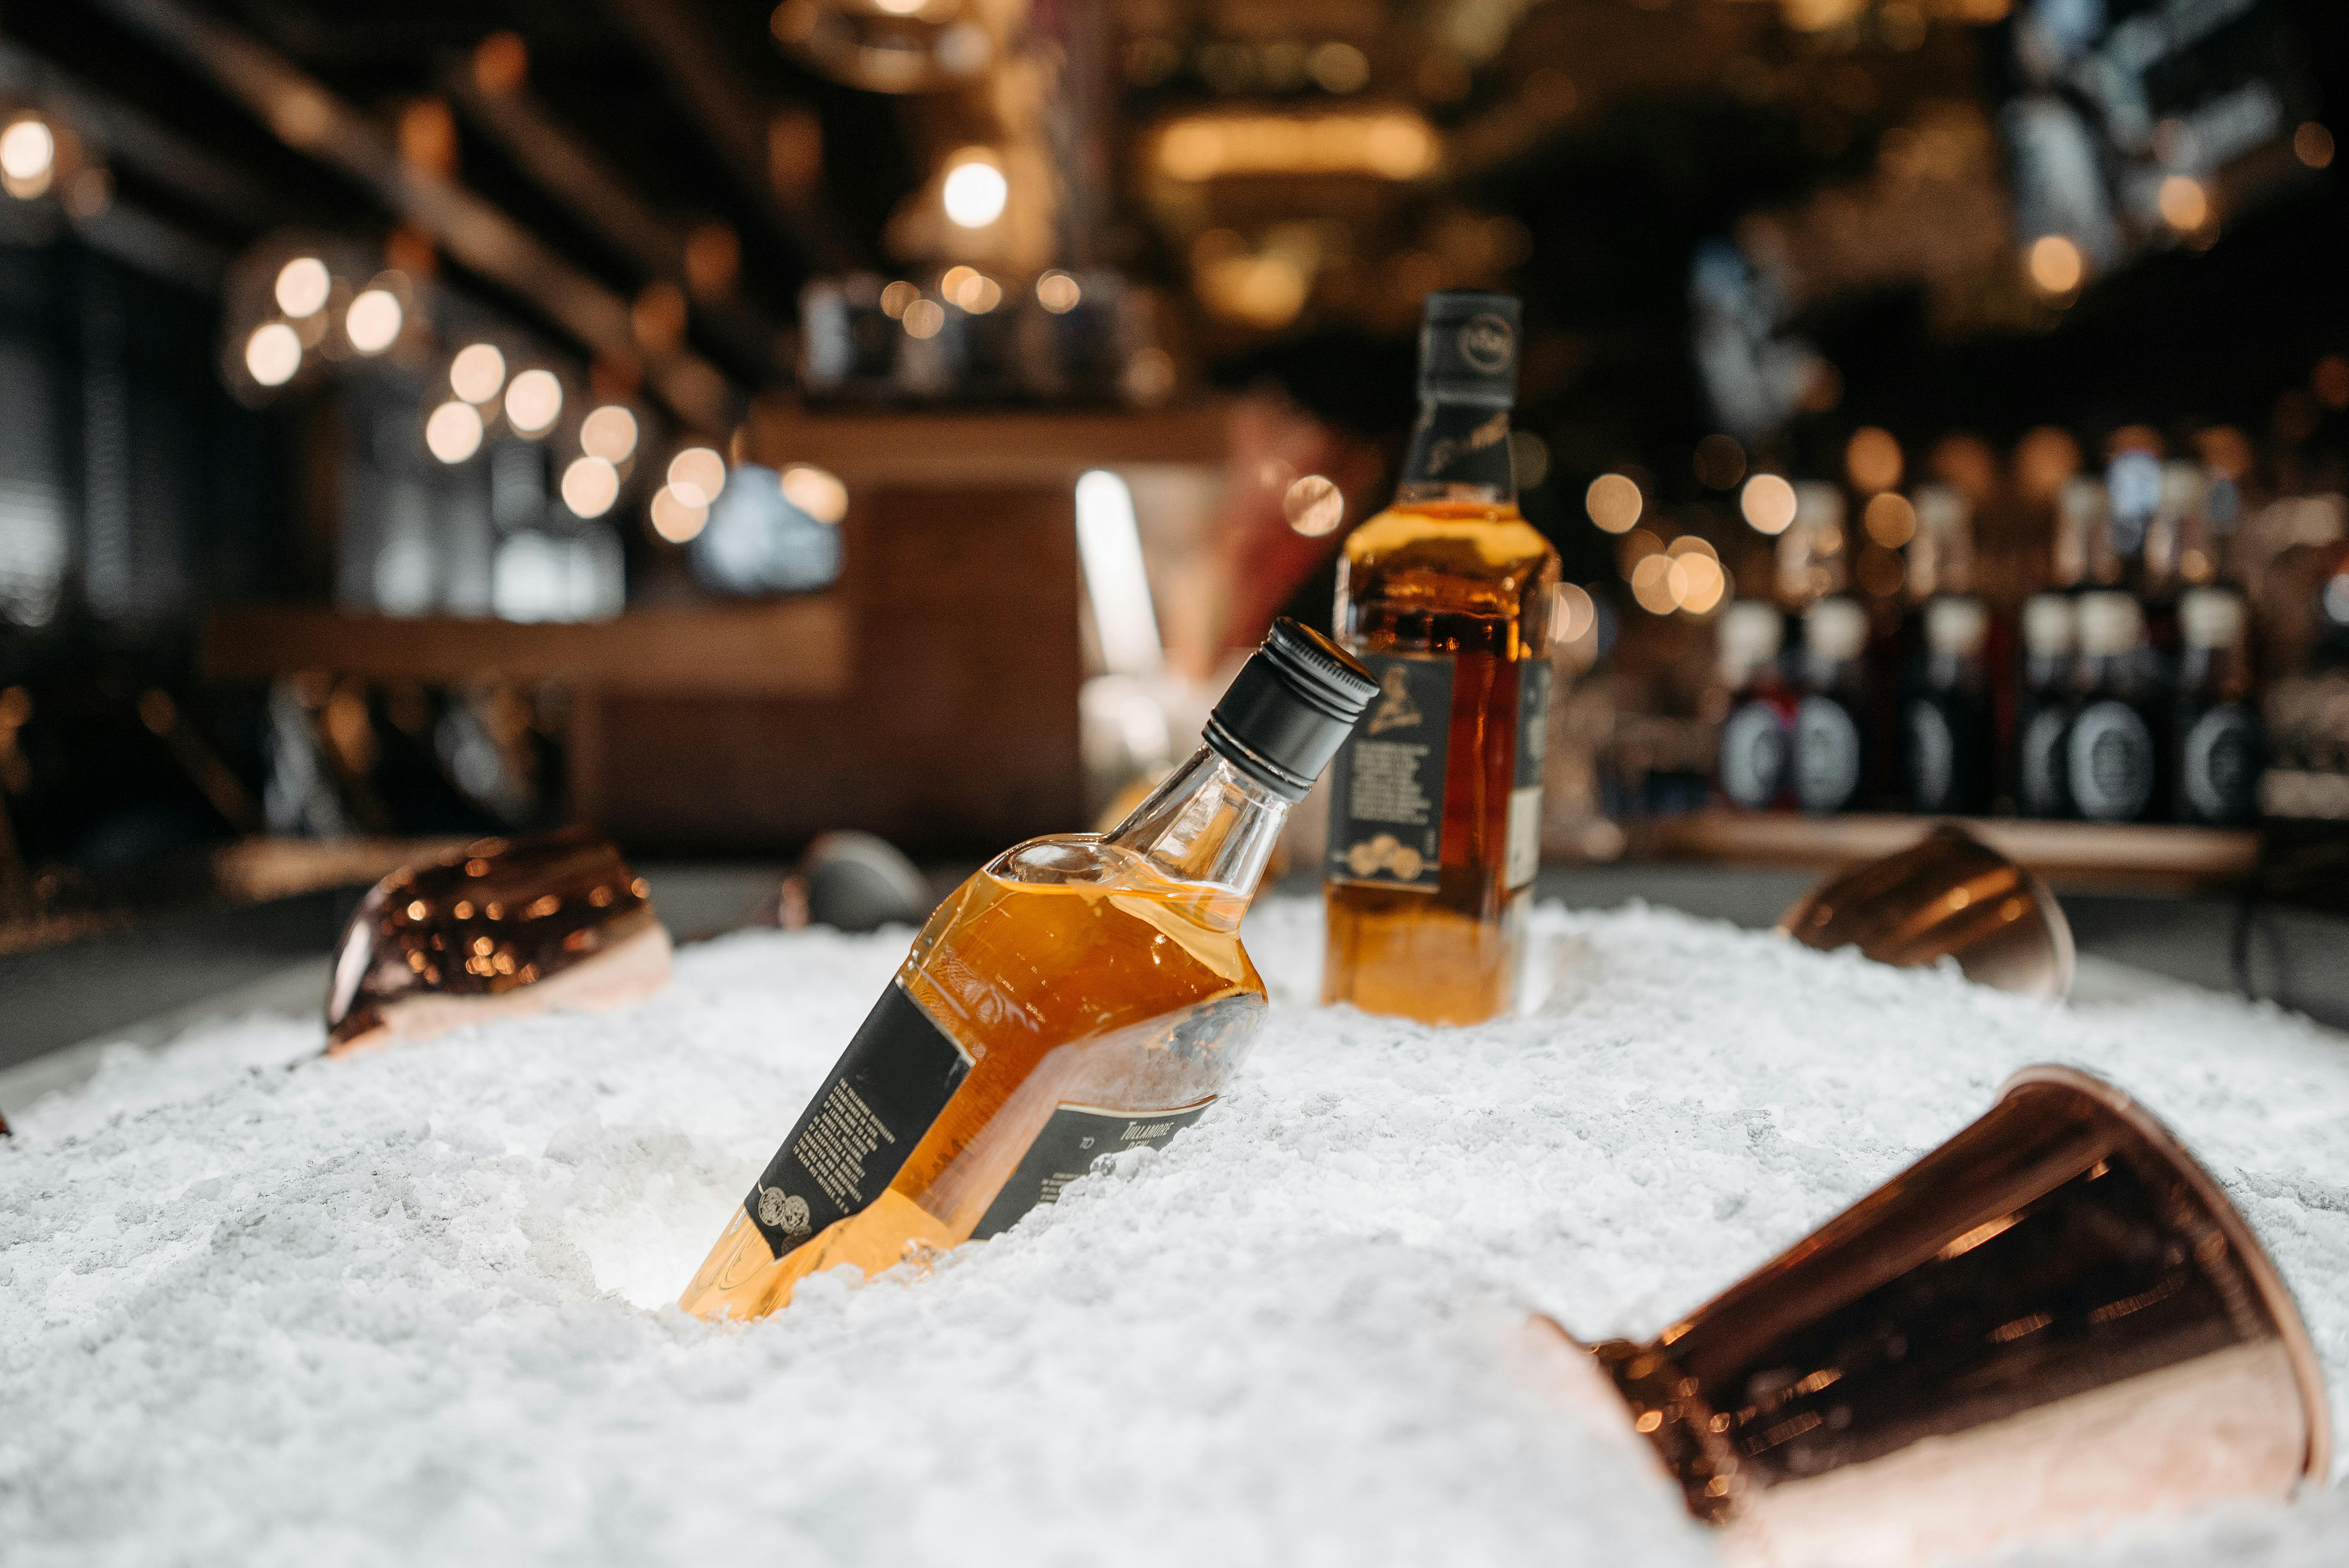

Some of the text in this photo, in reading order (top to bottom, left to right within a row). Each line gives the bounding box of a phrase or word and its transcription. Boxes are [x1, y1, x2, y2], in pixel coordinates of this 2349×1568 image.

[823, 1100, 831, 1110] OF
[828, 1108, 854, 1137] LEGENDARY
[828, 1093, 846, 1115] BECAME
[856, 1125, 864, 1136] TO
[833, 1085, 861, 1119] ESTABLISHED
[846, 1087, 871, 1117] TULLAMORE
[813, 1115, 821, 1126] HE
[818, 1123, 843, 1153] PERFECTED
[821, 1112, 837, 1133] DANIEL
[1120, 1121, 1175, 1141] TULLAMORE
[798, 1137, 809, 1152] THAT
[807, 1149, 818, 1163] WAS
[803, 1130, 827, 1160] CHARACTER
[824, 1158, 836, 1171] AND
[808, 1123, 815, 1132] OF
[813, 1130, 841, 1165] EXCEPTIONAL
[793, 1145, 800, 1155] TO
[798, 1152, 811, 1168] BEAR
[809, 1165, 818, 1178] HIS
